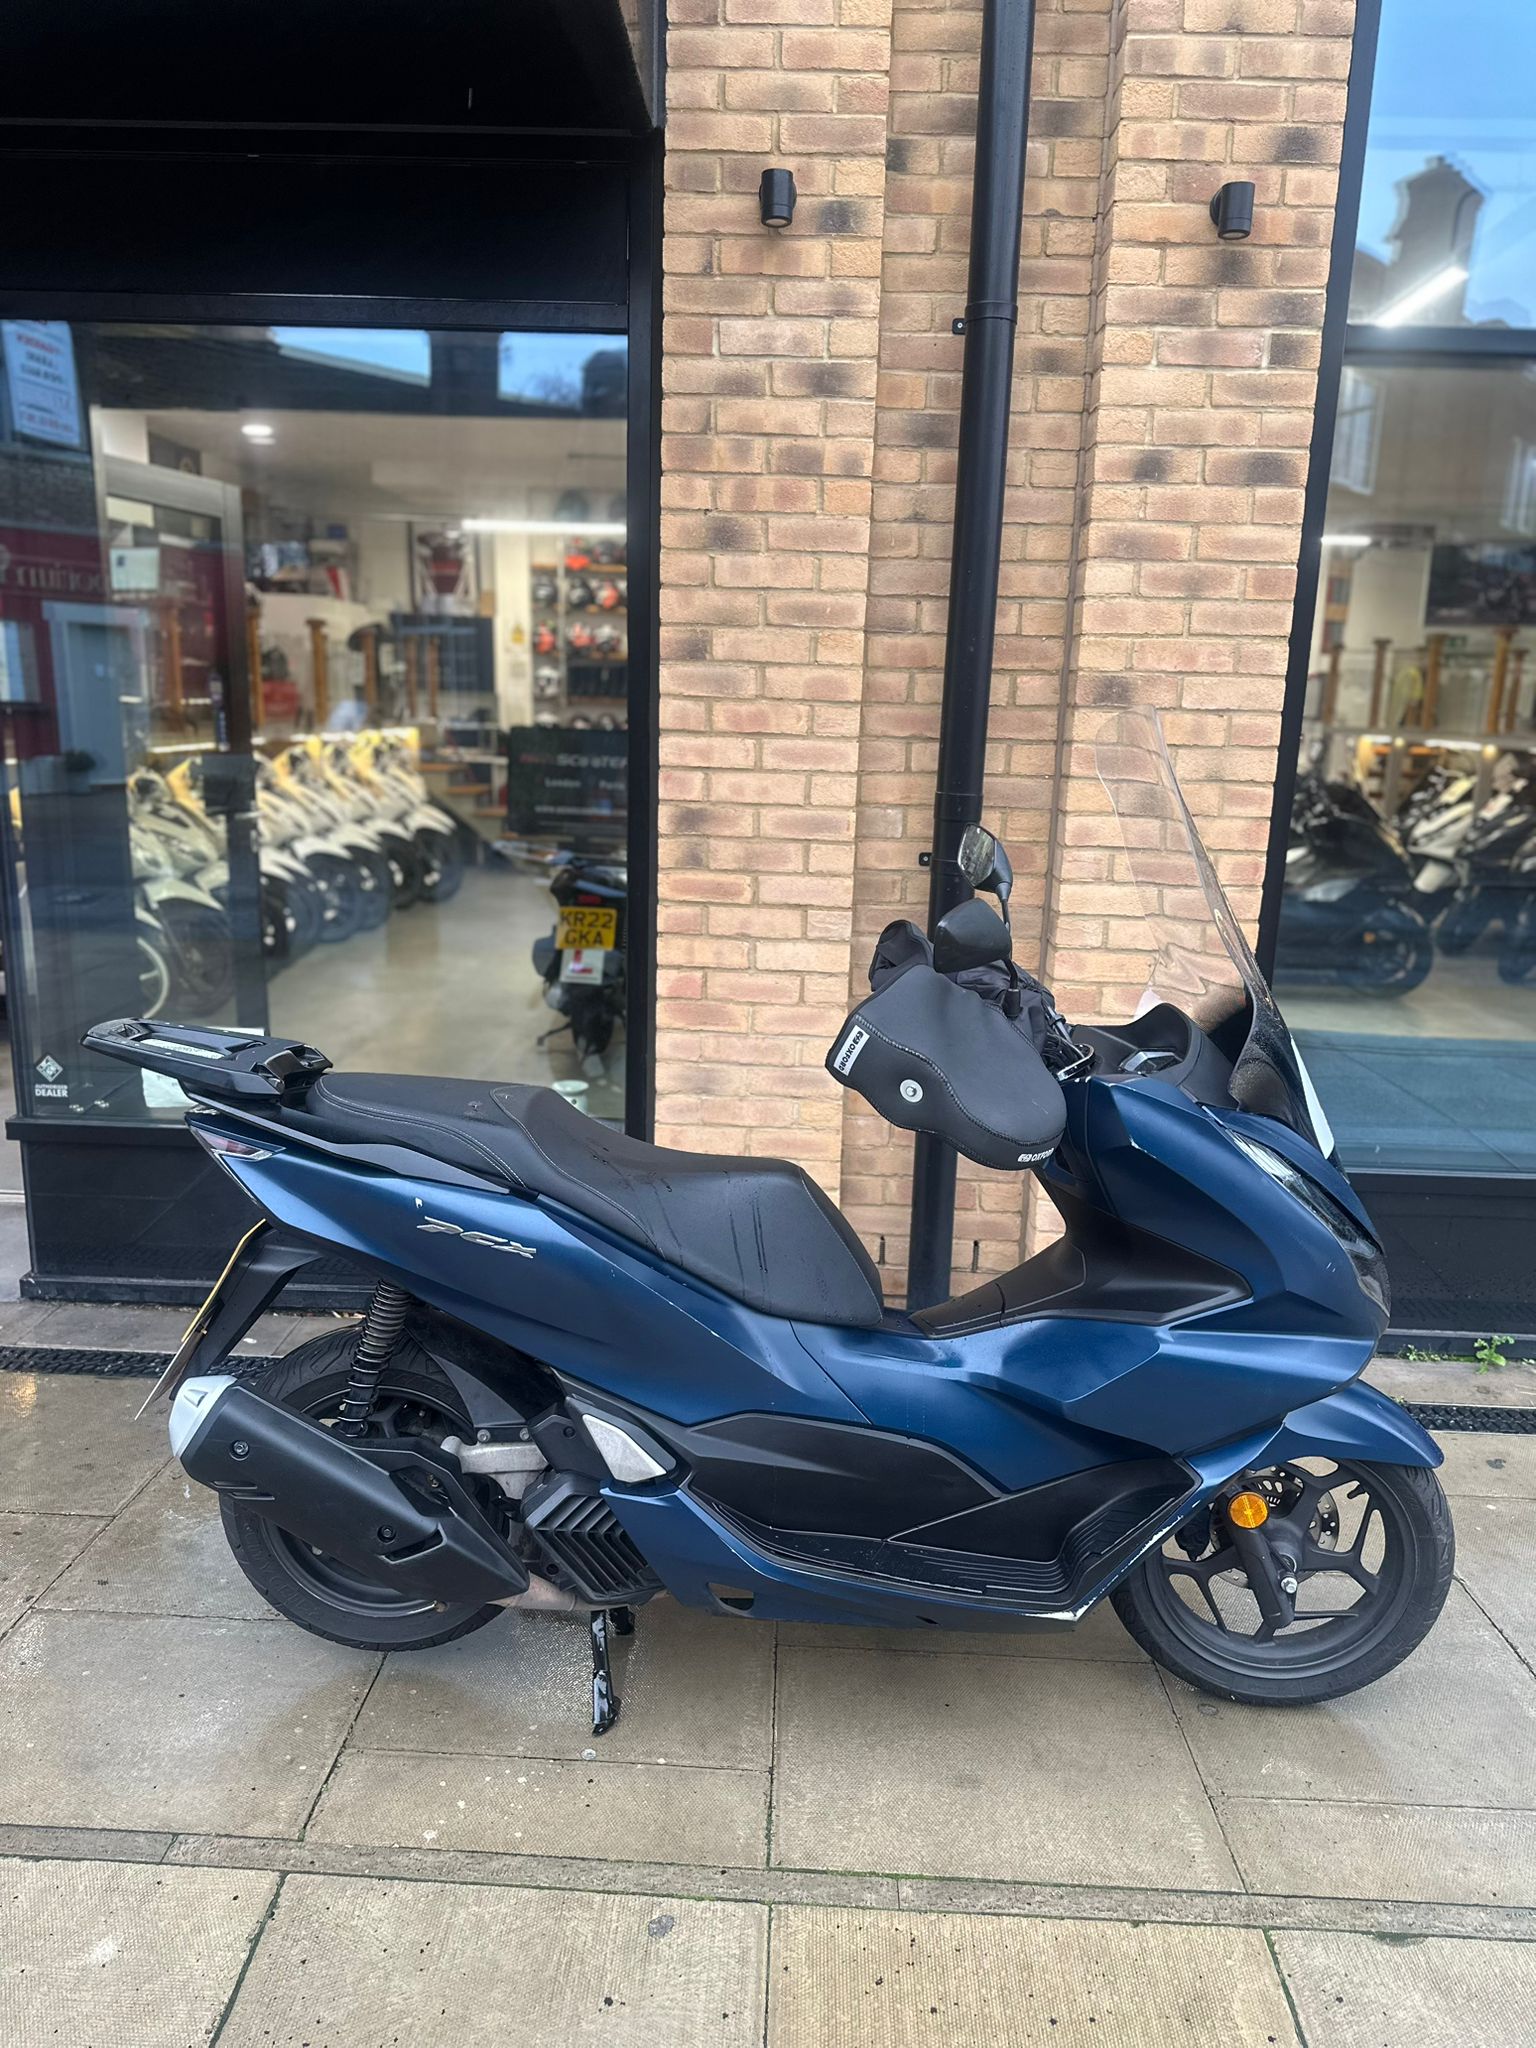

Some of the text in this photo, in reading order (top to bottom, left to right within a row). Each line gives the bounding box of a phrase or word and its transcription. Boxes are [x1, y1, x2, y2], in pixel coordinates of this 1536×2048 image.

[561, 910, 613, 929] KR22
[564, 929, 604, 945] GKA
[838, 1043, 856, 1071] OXFORD
[35, 1089, 69, 1097] DEALER
[416, 1215, 537, 1259] PCX
